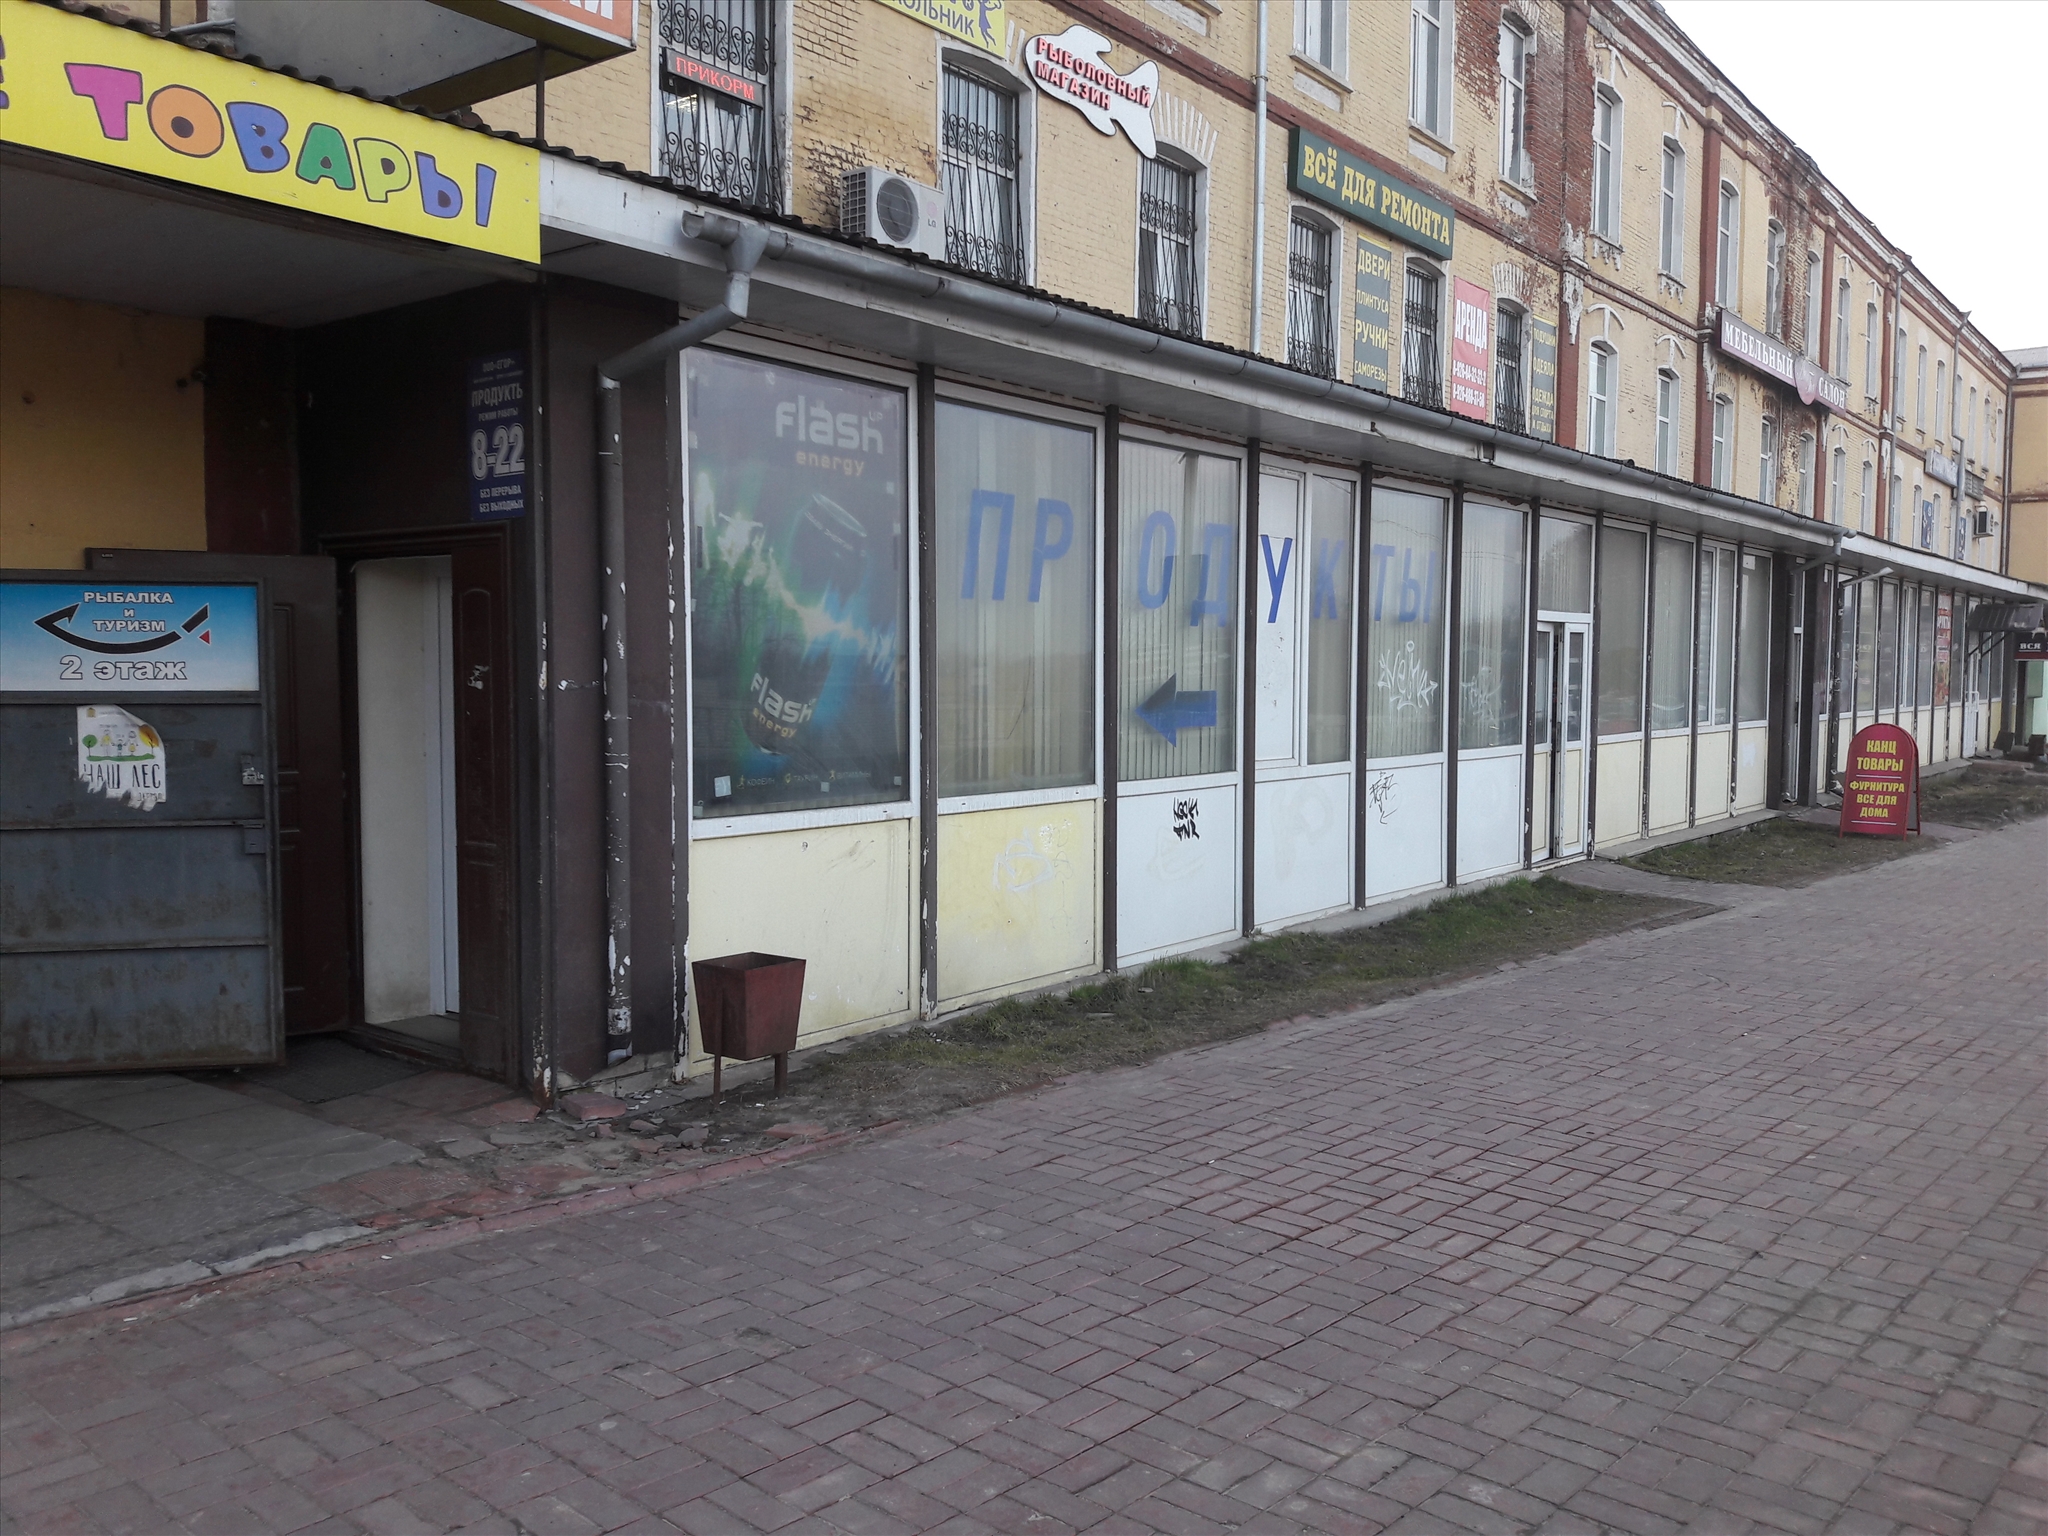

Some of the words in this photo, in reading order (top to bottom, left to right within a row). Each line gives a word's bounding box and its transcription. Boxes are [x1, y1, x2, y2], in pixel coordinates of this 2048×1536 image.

[898, 0, 974, 38] ОЛЬНИК
[676, 56, 754, 100] ПРИКОРМ
[1036, 60, 1111, 110] МАГАЗИН
[1037, 37, 1151, 108] РЫБОЛОВНЫЙ
[64, 62, 497, 228] ТОВАРЫ
[1303, 145, 1337, 190] ВСЁ
[1341, 165, 1376, 205] ДЛЯ
[1380, 185, 1450, 246] РЕМОНТА
[1357, 249, 1391, 282] ДВЕРИ
[1356, 289, 1389, 315] ПЛИНТУСА
[1355, 319, 1389, 351] РУЧКИ
[1454, 299, 1487, 354] АРЕНДА
[1354, 360, 1387, 383] САМОРЕЗЫ
[1532, 356, 1554, 376] ОДЕЯЛА
[1724, 321, 1794, 379] МЕБЕЛЬНЫЙ
[1819, 376, 1845, 409] САЛОН
[1532, 387, 1554, 407] ОДЕЖДА
[471, 422, 525, 480] 8-22
[796, 451, 865, 476] energy
[83, 592, 174, 604] РЫБАЛКА
[92, 620, 166, 632] ТУРИЗМ
[2020, 642, 2041, 650] ВСЯ
[59, 655, 83, 680] 2
[93, 661, 188, 680] этаж
[752, 707, 797, 739] energy
[1866, 740, 1897, 755] КАНЦ
[132, 763, 161, 789] ЛЕС
[1857, 757, 1904, 771] ТОВАРЫ
[1850, 781, 1905, 792] ФУРНИТУРА
[1857, 794, 1874, 804] ВСЕ
[1876, 795, 1897, 806] ДЛЯ
[1860, 807, 1888, 818] ДОМА
